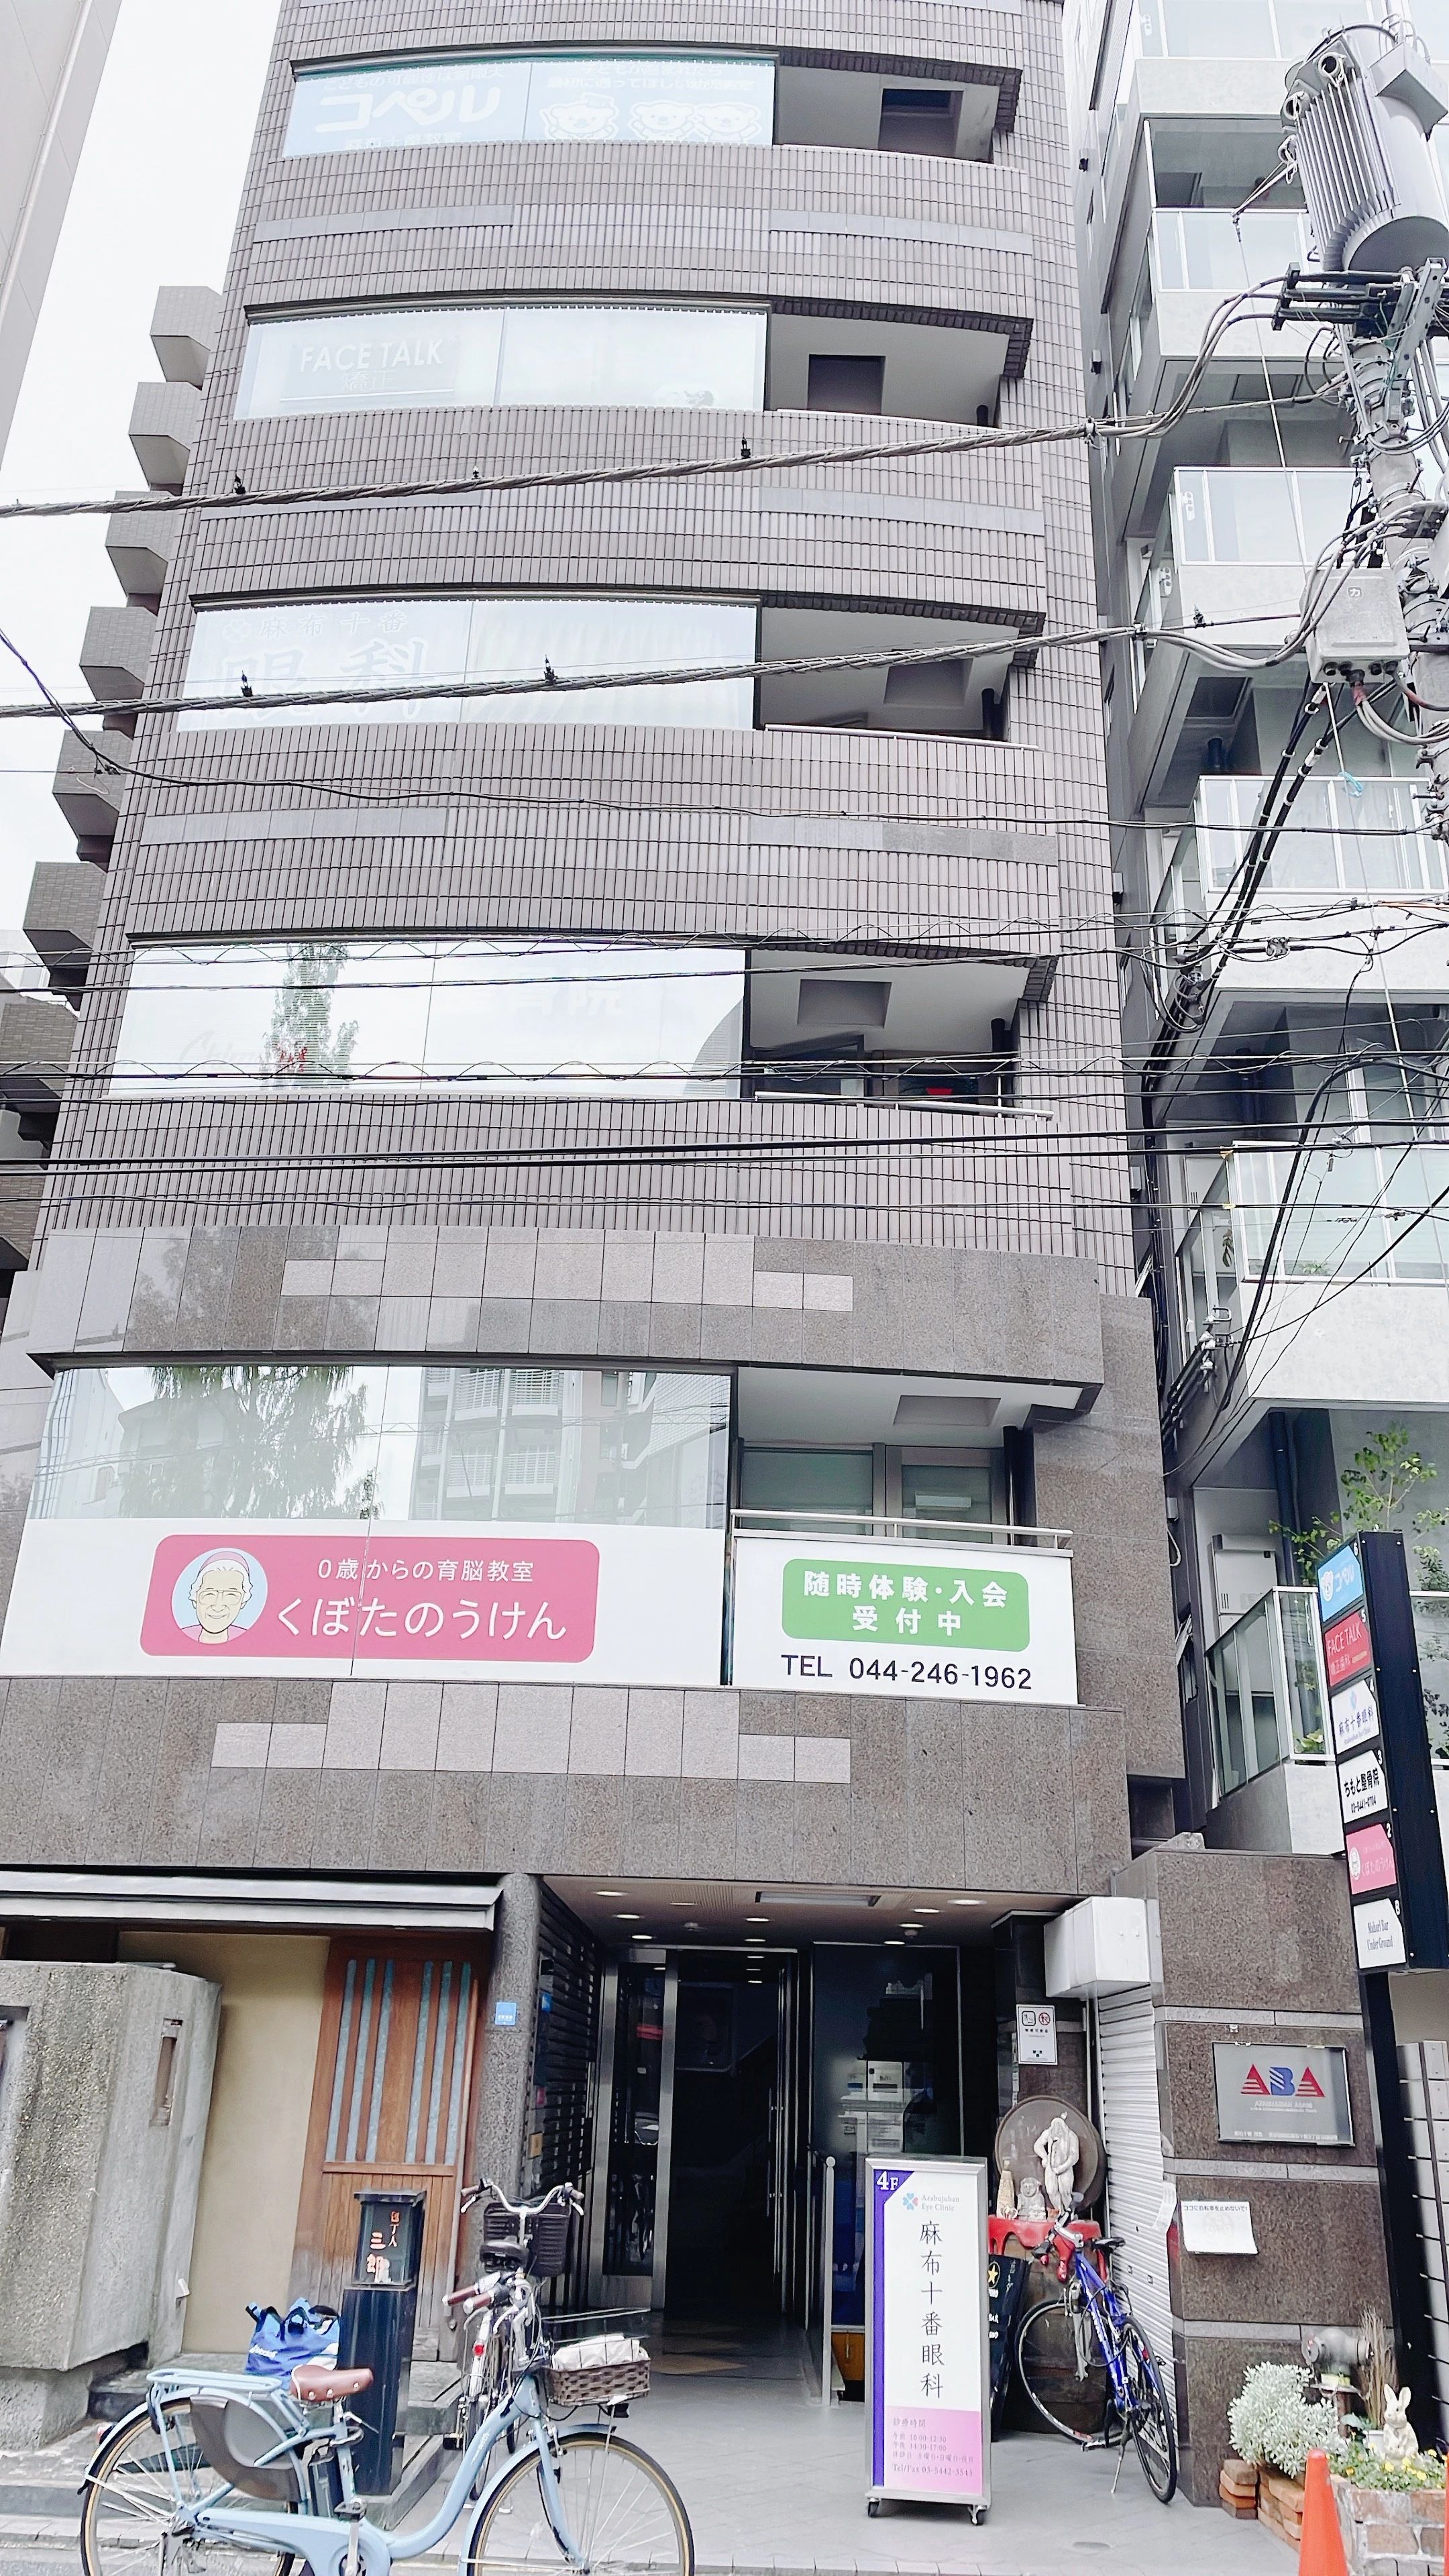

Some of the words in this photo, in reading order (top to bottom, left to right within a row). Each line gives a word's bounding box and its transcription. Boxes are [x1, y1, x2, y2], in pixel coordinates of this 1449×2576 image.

[315, 85, 501, 133] コペル
[300, 343, 372, 372] FACE
[380, 339, 443, 368] TALK
[341, 370, 396, 392] 矯正
[260, 610, 411, 639] 麻布十番
[221, 637, 429, 724] 眼科
[1354, 1542, 1358, 1556] 6
[276, 1595, 567, 1641] くぼたのうけん
[852, 1605, 962, 1636] 受付中
[1361, 1609, 1366, 1623] 5
[1327, 1631, 1344, 1658] FACE
[1344, 1624, 1362, 1646] TALK
[781, 1654, 833, 1677] TEL
[849, 1658, 1032, 1690] 044-246-1962
[1377, 1750, 1383, 1765] 3
[1344, 1768, 1379, 1797] ちもと整骨院
[1387, 1823, 1392, 1838] 2
[1240, 2064, 1325, 2097] ABA
[876, 2170, 899, 2191] 4F
[922, 2203, 932, 2211] Eye
[920, 2220, 945, 2400] 麻布十番眼科
